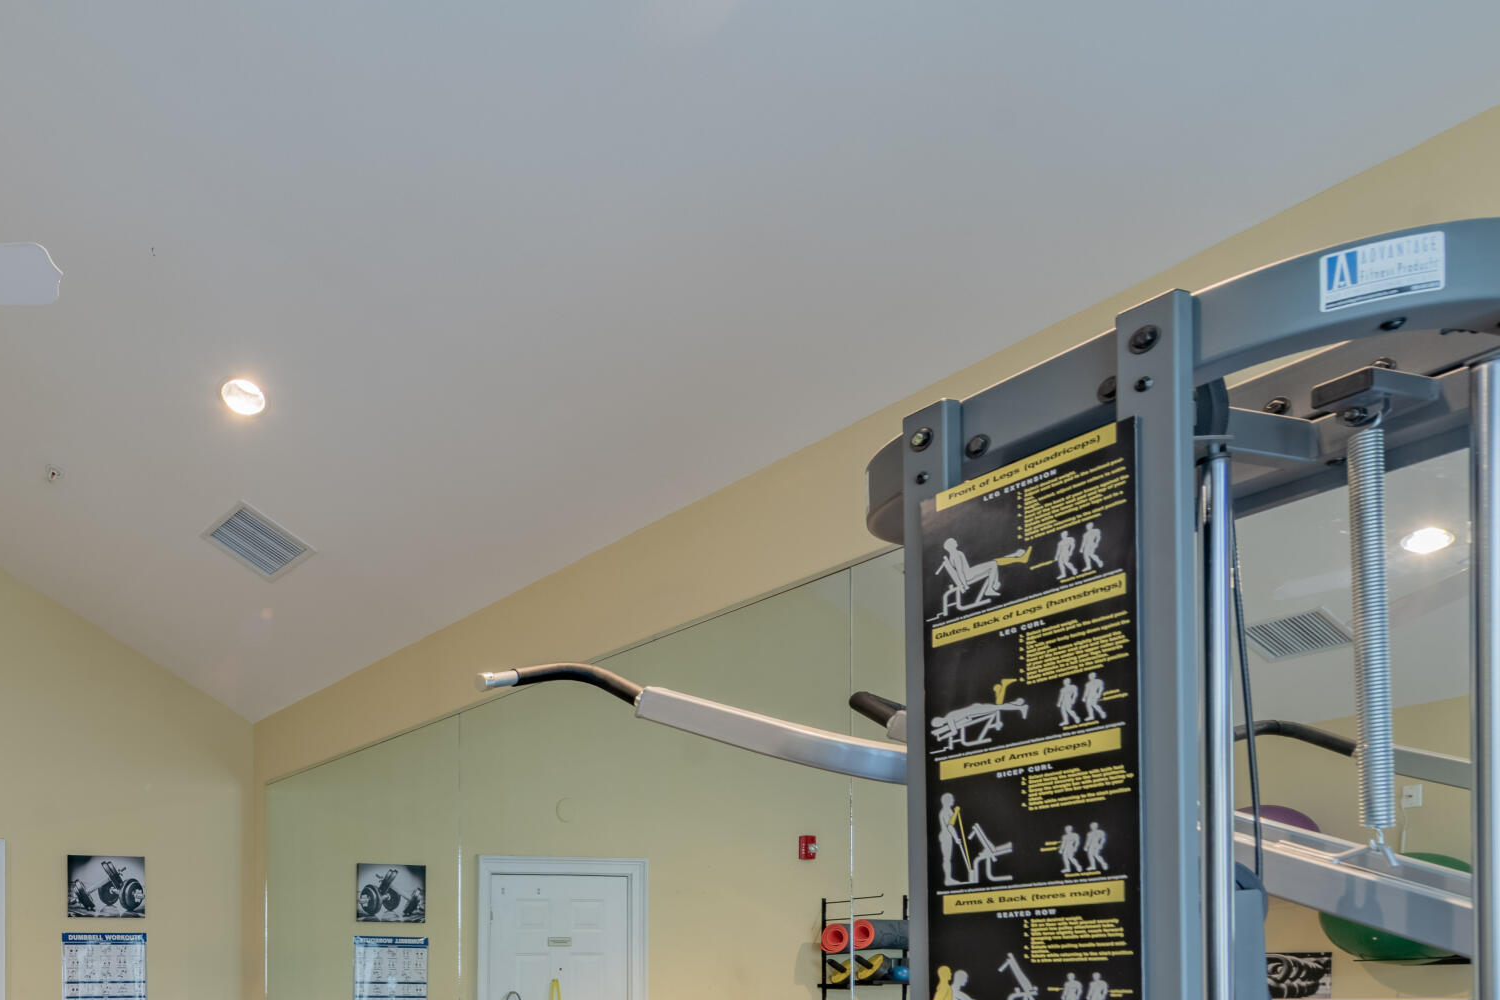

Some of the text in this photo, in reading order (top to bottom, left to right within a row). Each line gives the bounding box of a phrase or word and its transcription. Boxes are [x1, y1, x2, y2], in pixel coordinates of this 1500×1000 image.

[1361, 236, 1437, 264] ADVANTAGE
[948, 435, 1101, 500] Front of Legs (quadriceps)
[983, 469, 1058, 502] LEG EXTENSION
[935, 580, 1122, 640] Glutes, Back of Legs (hamstrings)
[999, 620, 1046, 637] LEG CURL
[963, 739, 1092, 769] Front of Arms (biceps)
[996, 763, 1053, 779] BICEP CURL
[955, 887, 1111, 907] Arms & Back (teres major)
[996, 908, 1057, 919] SEATED ROW
